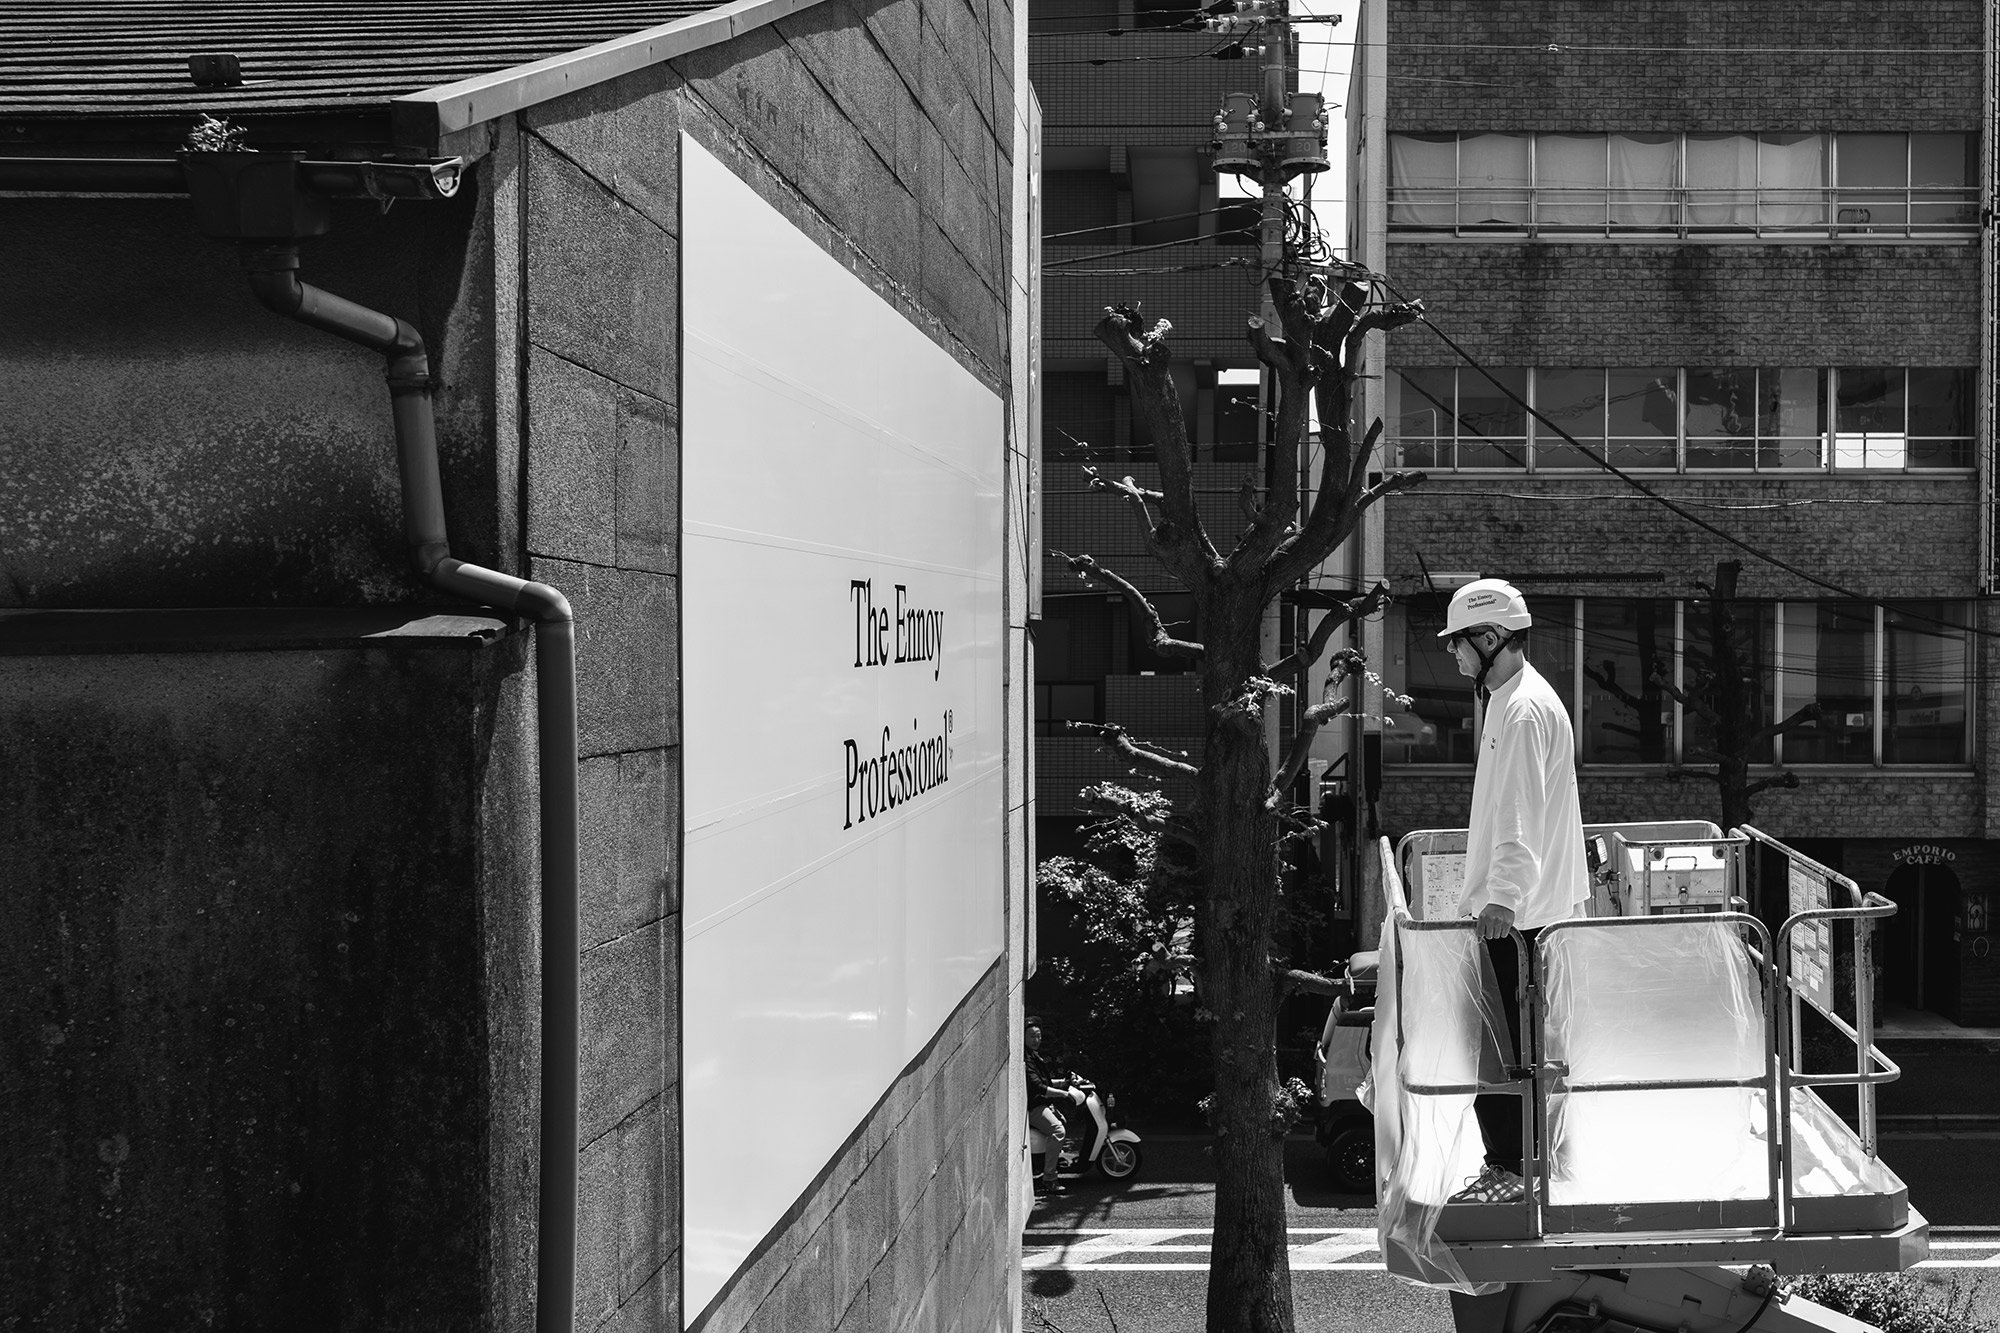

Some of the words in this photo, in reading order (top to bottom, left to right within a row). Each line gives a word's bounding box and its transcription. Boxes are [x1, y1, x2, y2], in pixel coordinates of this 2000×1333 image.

[850, 578, 889, 667] The
[894, 584, 944, 682] Ennoy
[1892, 845, 1956, 861] EMPORIO
[1906, 855, 1941, 865] CAFE
